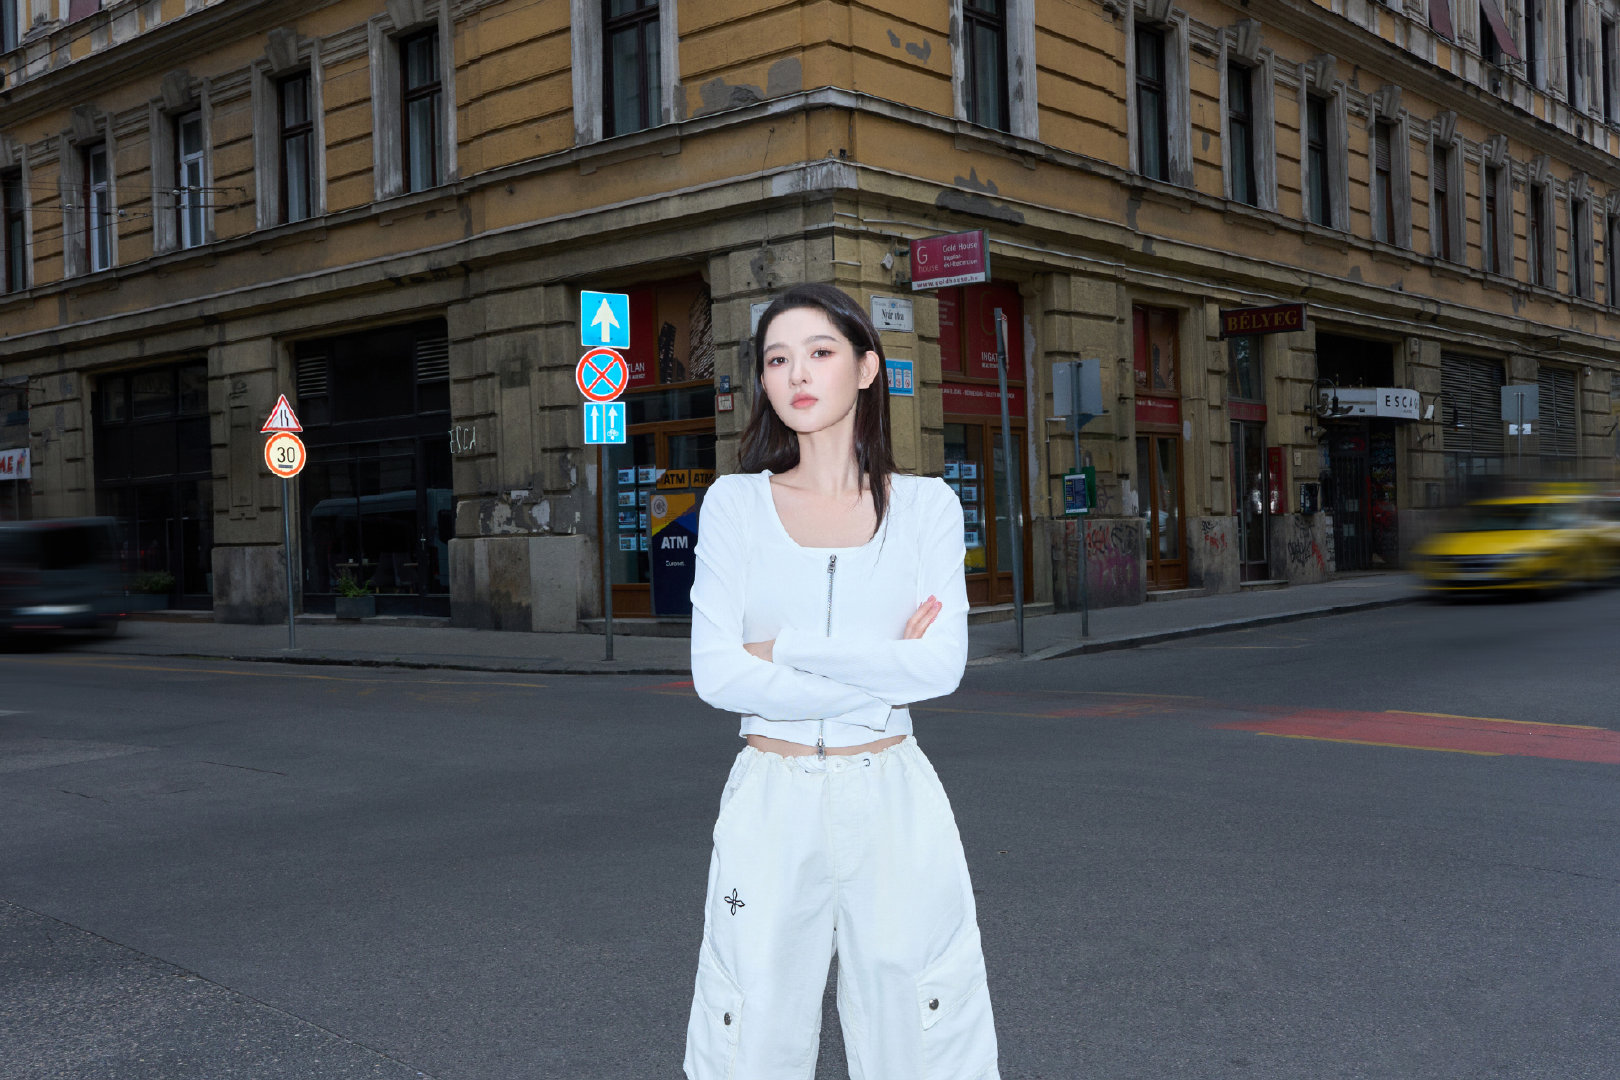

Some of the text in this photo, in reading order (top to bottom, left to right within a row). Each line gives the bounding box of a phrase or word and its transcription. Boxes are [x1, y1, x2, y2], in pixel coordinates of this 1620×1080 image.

[959, 242, 978, 250] House
[917, 246, 928, 264] G
[918, 264, 939, 273] house
[1227, 310, 1298, 331] BÉLYEG
[277, 446, 296, 463] 30
[664, 473, 685, 485] ATM
[661, 536, 688, 550] ATM
